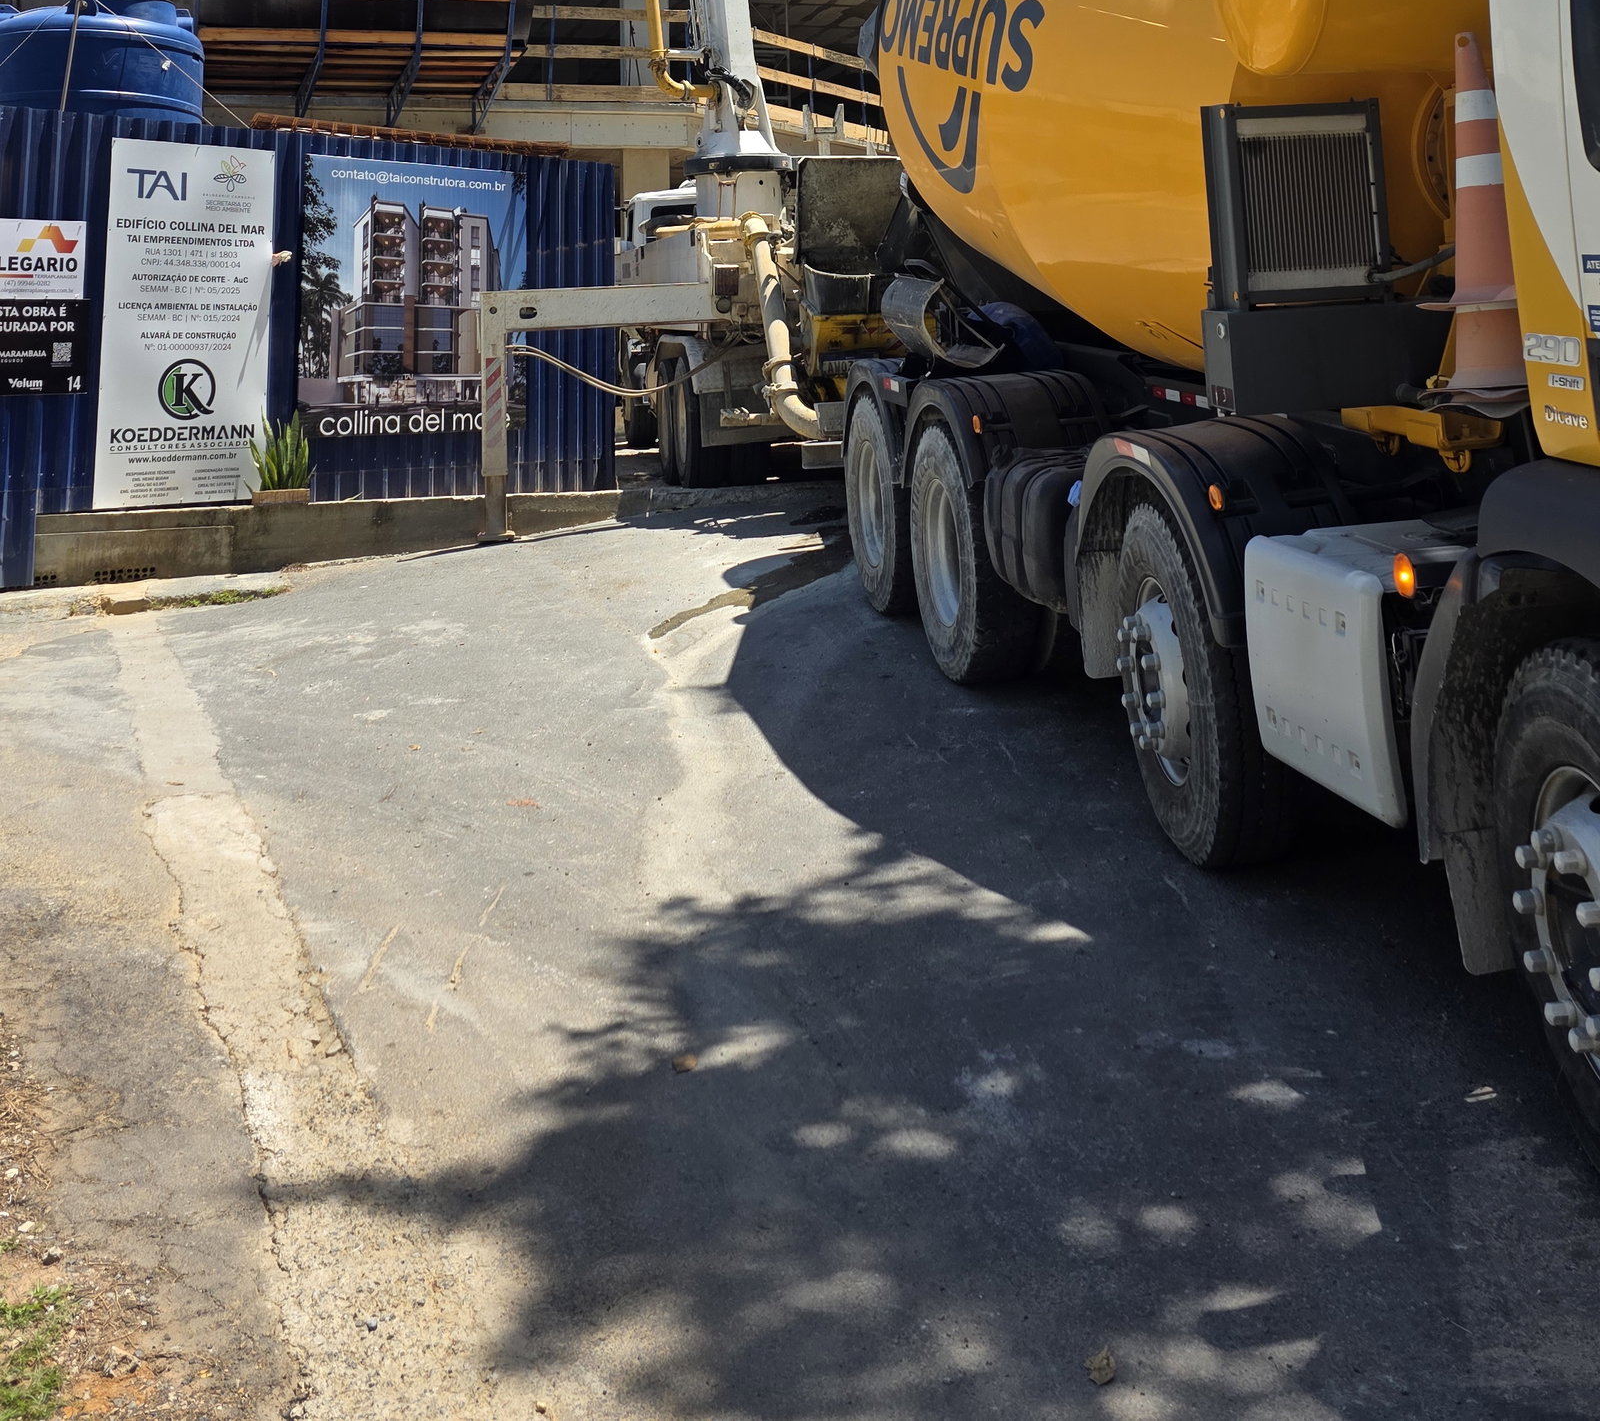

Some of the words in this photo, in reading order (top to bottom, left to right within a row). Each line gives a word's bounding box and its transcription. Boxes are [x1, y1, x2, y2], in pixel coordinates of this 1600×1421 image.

[127, 168, 187, 201] TAI
[331, 168, 506, 192] contato@taiconstrutora.com.br
[116, 217, 166, 230] EDIFÍCIO
[169, 221, 215, 233] COLLINA
[218, 223, 238, 234] DEL
[240, 224, 265, 235] MAR
[127, 234, 141, 243] TAI
[144, 236, 232, 247] EMPREENDIMENTOS
[234, 240, 255, 248] LTDA
[163, 249, 182, 257] 1301
[190, 250, 203, 258] 471
[219, 251, 238, 259] 1803
[141, 258, 162, 267] CNPJ:
[163, 259, 241, 269] 44.348.338/0001-04
[132, 274, 187, 284] AUTORIZAÇÃO
[22, 306, 56, 317] OBRA
[60, 303, 67, 317] É
[118, 302, 152, 310] LICENÇA
[154, 303, 199, 311] AMBIENTAL
[212, 302, 258, 312] INSTALAÇÃO
[203, 315, 241, 323] 015/2024
[50, 321, 75, 332] POR
[140, 330, 172, 339] ALVARÁ
[185, 331, 237, 341] CONSTRUÇÃO
[1524, 332, 1581, 365] 290
[8, 378, 43, 388] Yelum
[67, 375, 81, 392] 14
[1551, 375, 1581, 390] I-Shift
[319, 410, 400, 436] collina
[408, 408, 445, 433] del
[1544, 405, 1589, 429] Dicave
[110, 424, 255, 444] KOEDDERMANN
[110, 442, 187, 452] CONSULTORES
[190, 440, 249, 449] ASSOCIADO
[128, 452, 237, 464] www.koeddermann.com.br
